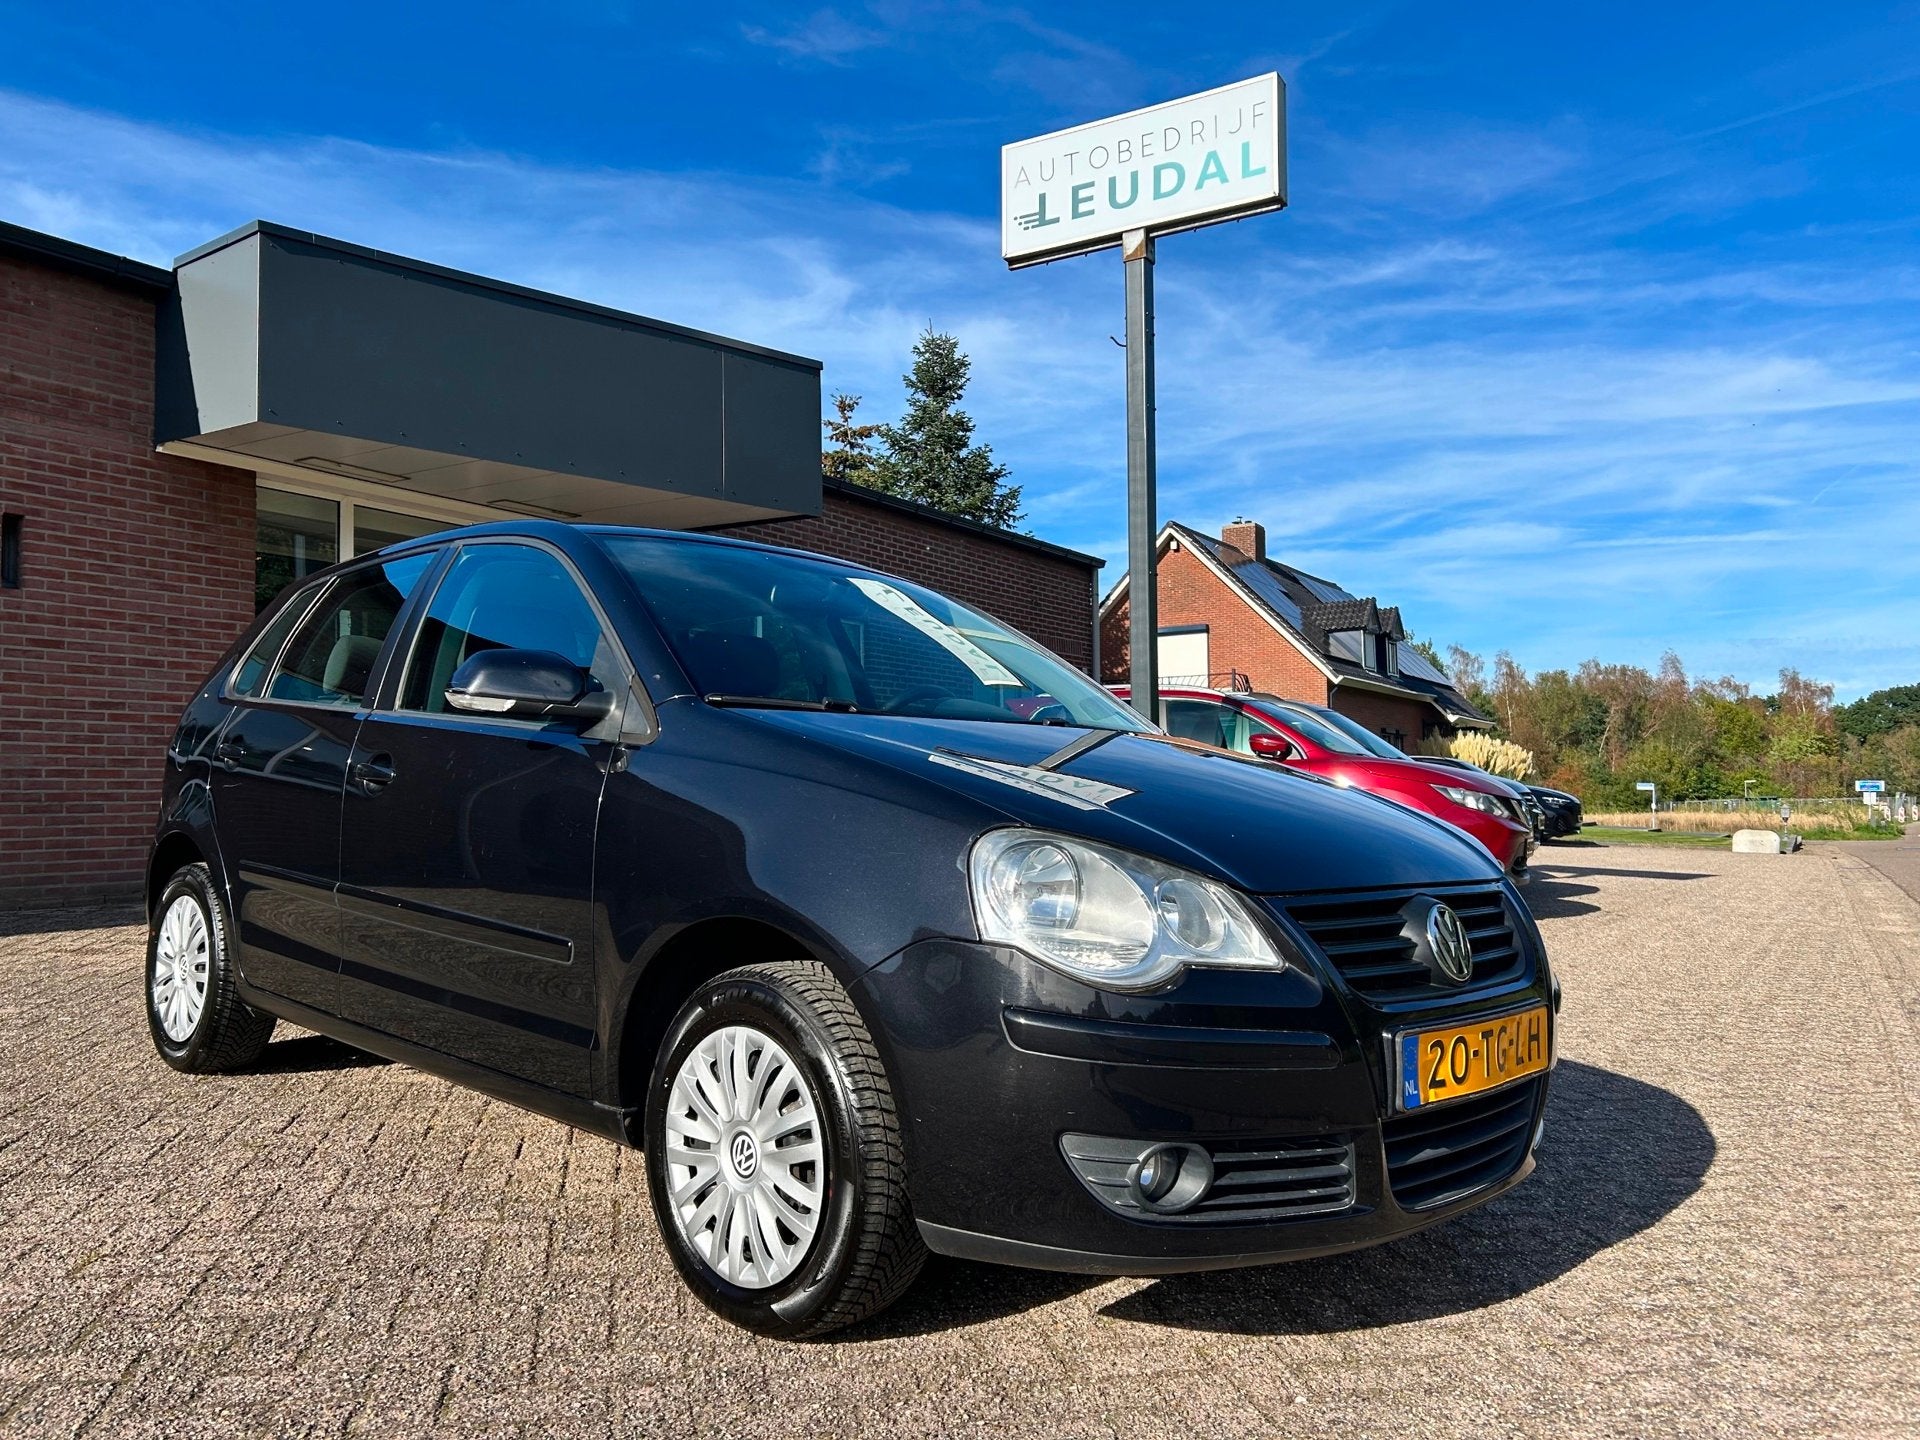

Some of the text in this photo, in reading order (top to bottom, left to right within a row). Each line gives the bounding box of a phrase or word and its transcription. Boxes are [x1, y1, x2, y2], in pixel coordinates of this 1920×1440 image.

[1014, 101, 1266, 188] AUTOBEDRIJF
[1032, 140, 1266, 228] LEUDAL
[1405, 1080, 1418, 1096] NL
[1427, 1014, 1542, 1090] 20-TG-LH
